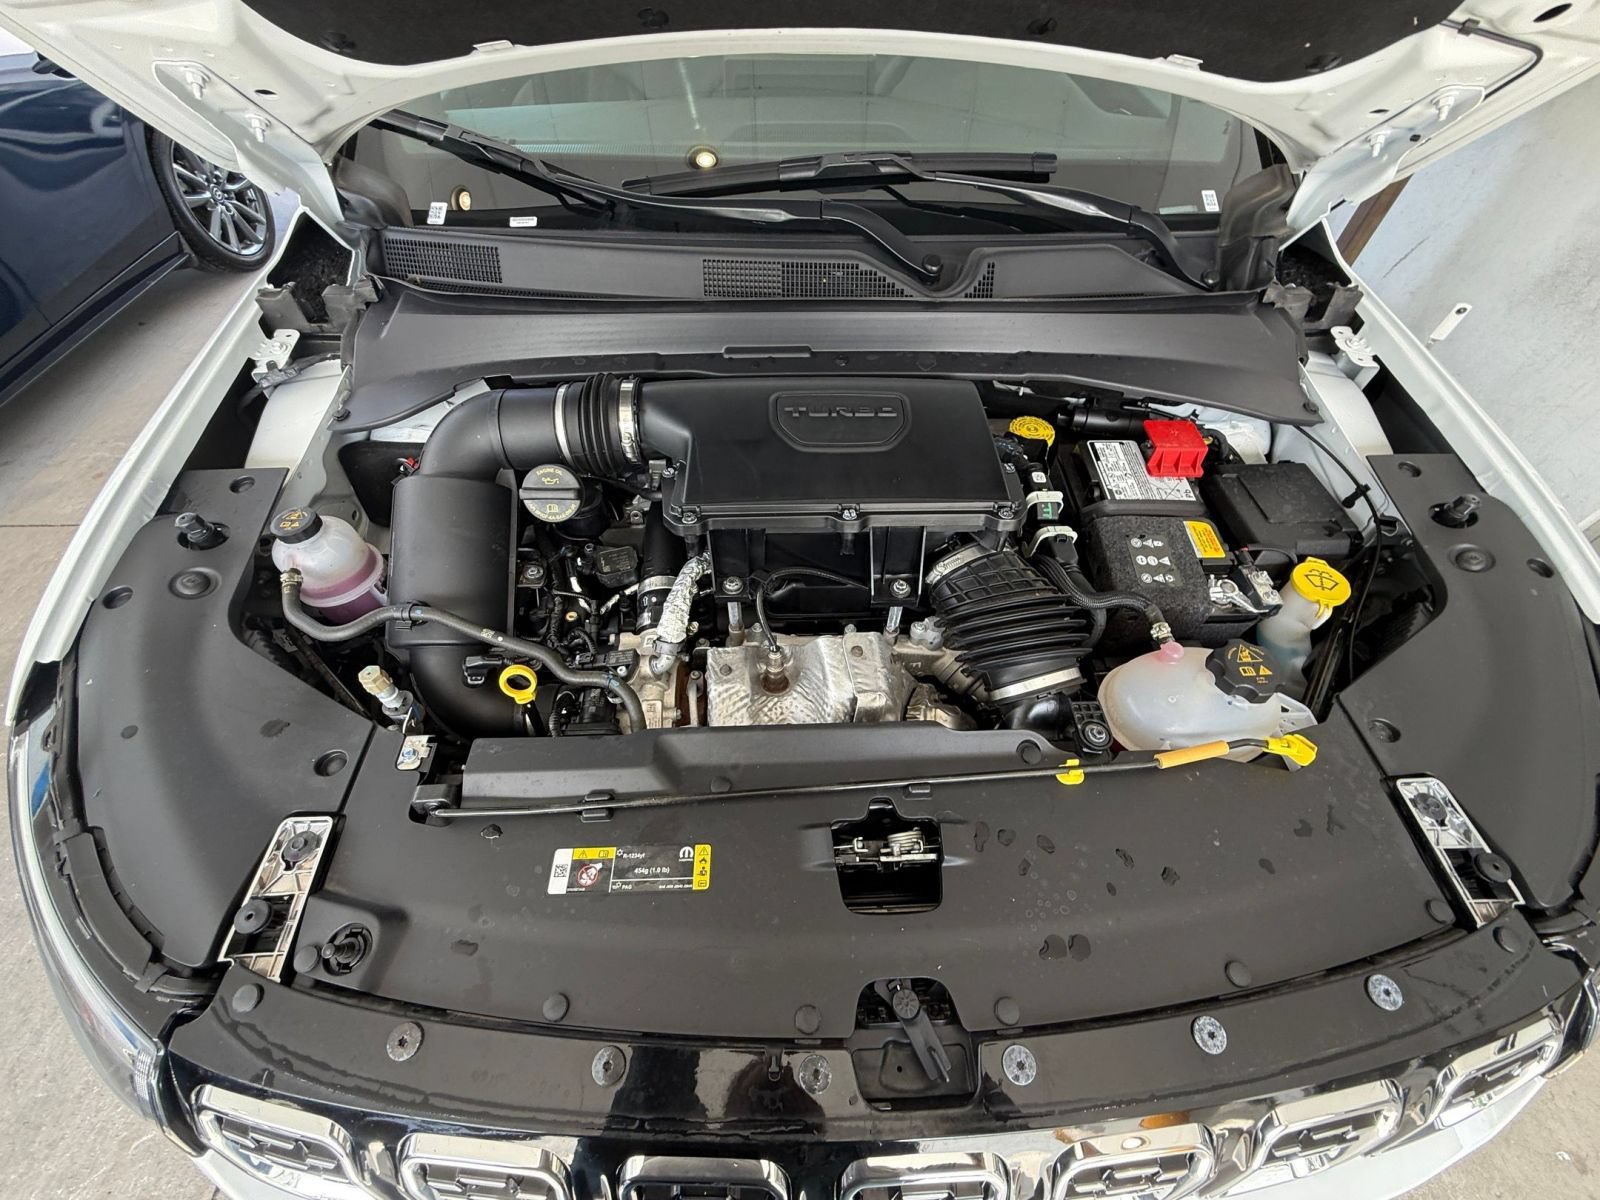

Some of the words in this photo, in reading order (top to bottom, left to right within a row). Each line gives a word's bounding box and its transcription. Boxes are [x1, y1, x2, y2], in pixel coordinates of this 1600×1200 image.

[783, 406, 898, 418] TURBO
[622, 852, 646, 860] R-1234yf
[633, 867, 649, 875] 454g
